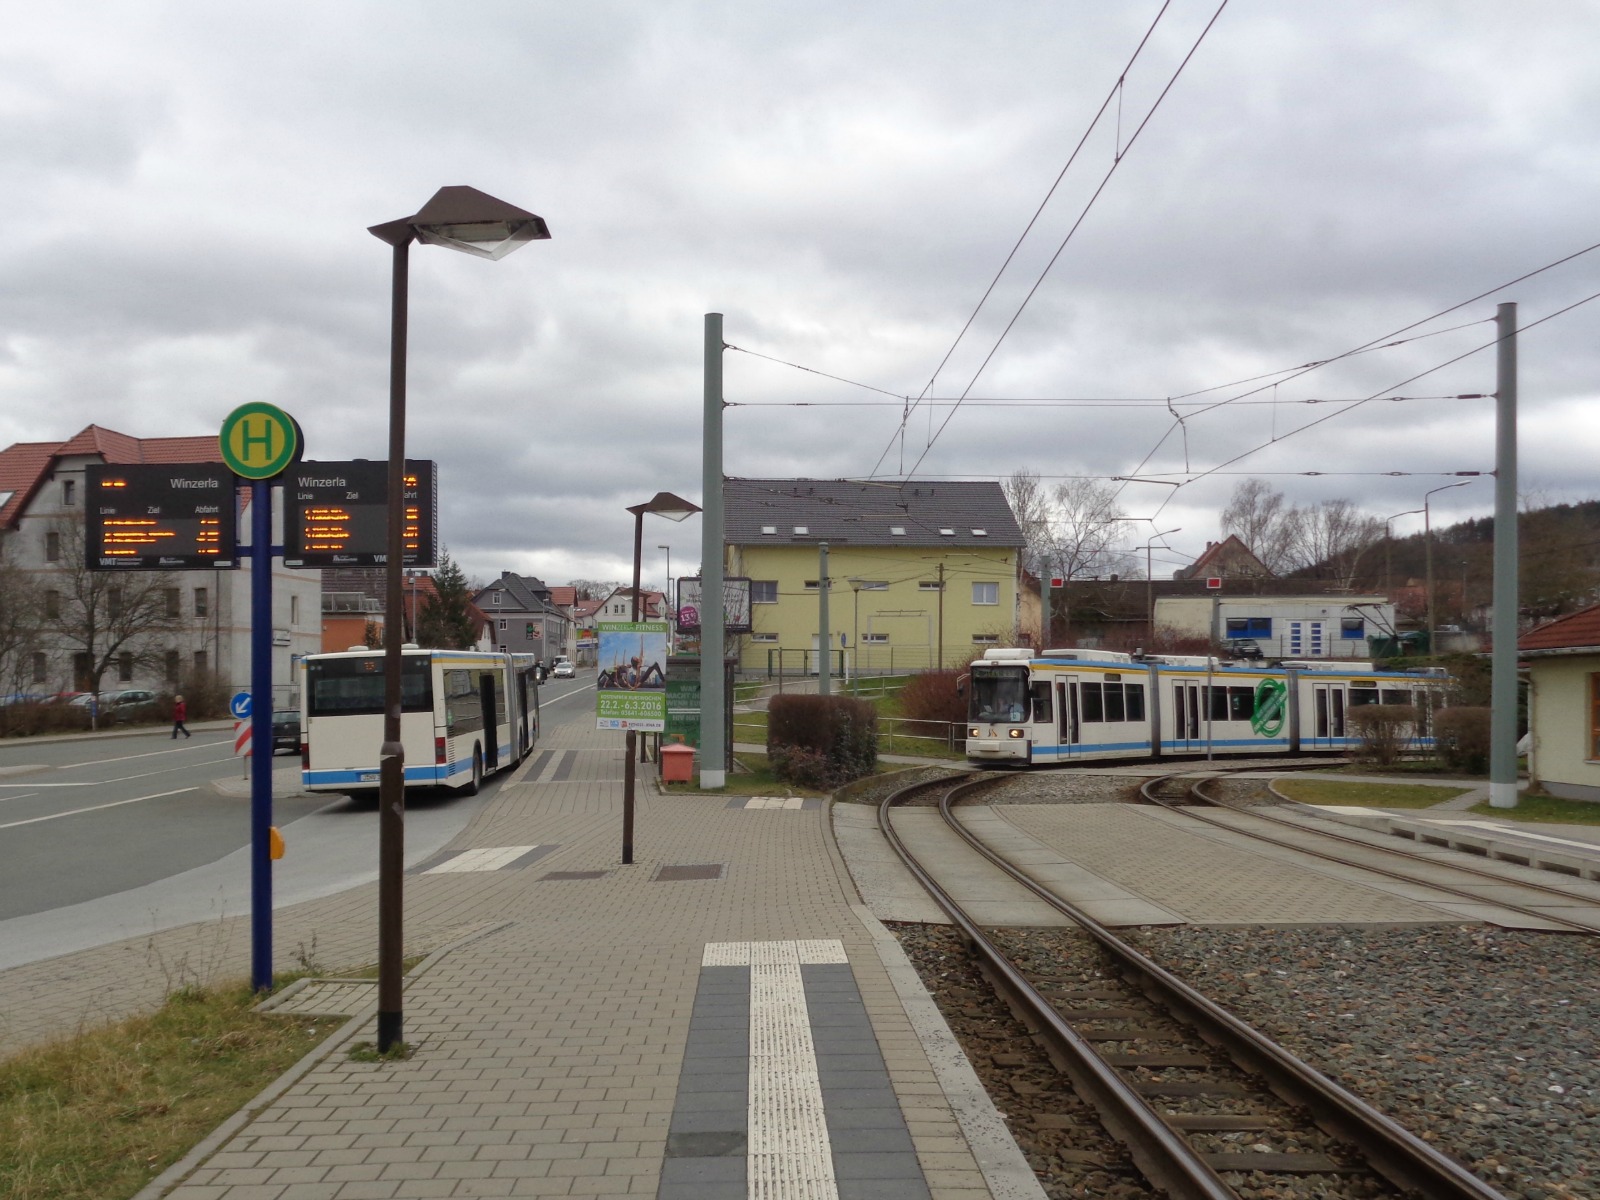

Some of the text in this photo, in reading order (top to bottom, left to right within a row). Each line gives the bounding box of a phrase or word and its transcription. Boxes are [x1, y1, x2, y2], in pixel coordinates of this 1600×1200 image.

[242, 419, 272, 462] H
[170, 478, 219, 489] Winzerla
[298, 477, 346, 487] Winzerla
[298, 492, 313, 500] Linie
[100, 505, 219, 515] Linie Ziel Abfahrt
[100, 558, 117, 566] VMT
[374, 555, 387, 563] VM
[635, 624, 664, 632] FITNESS
